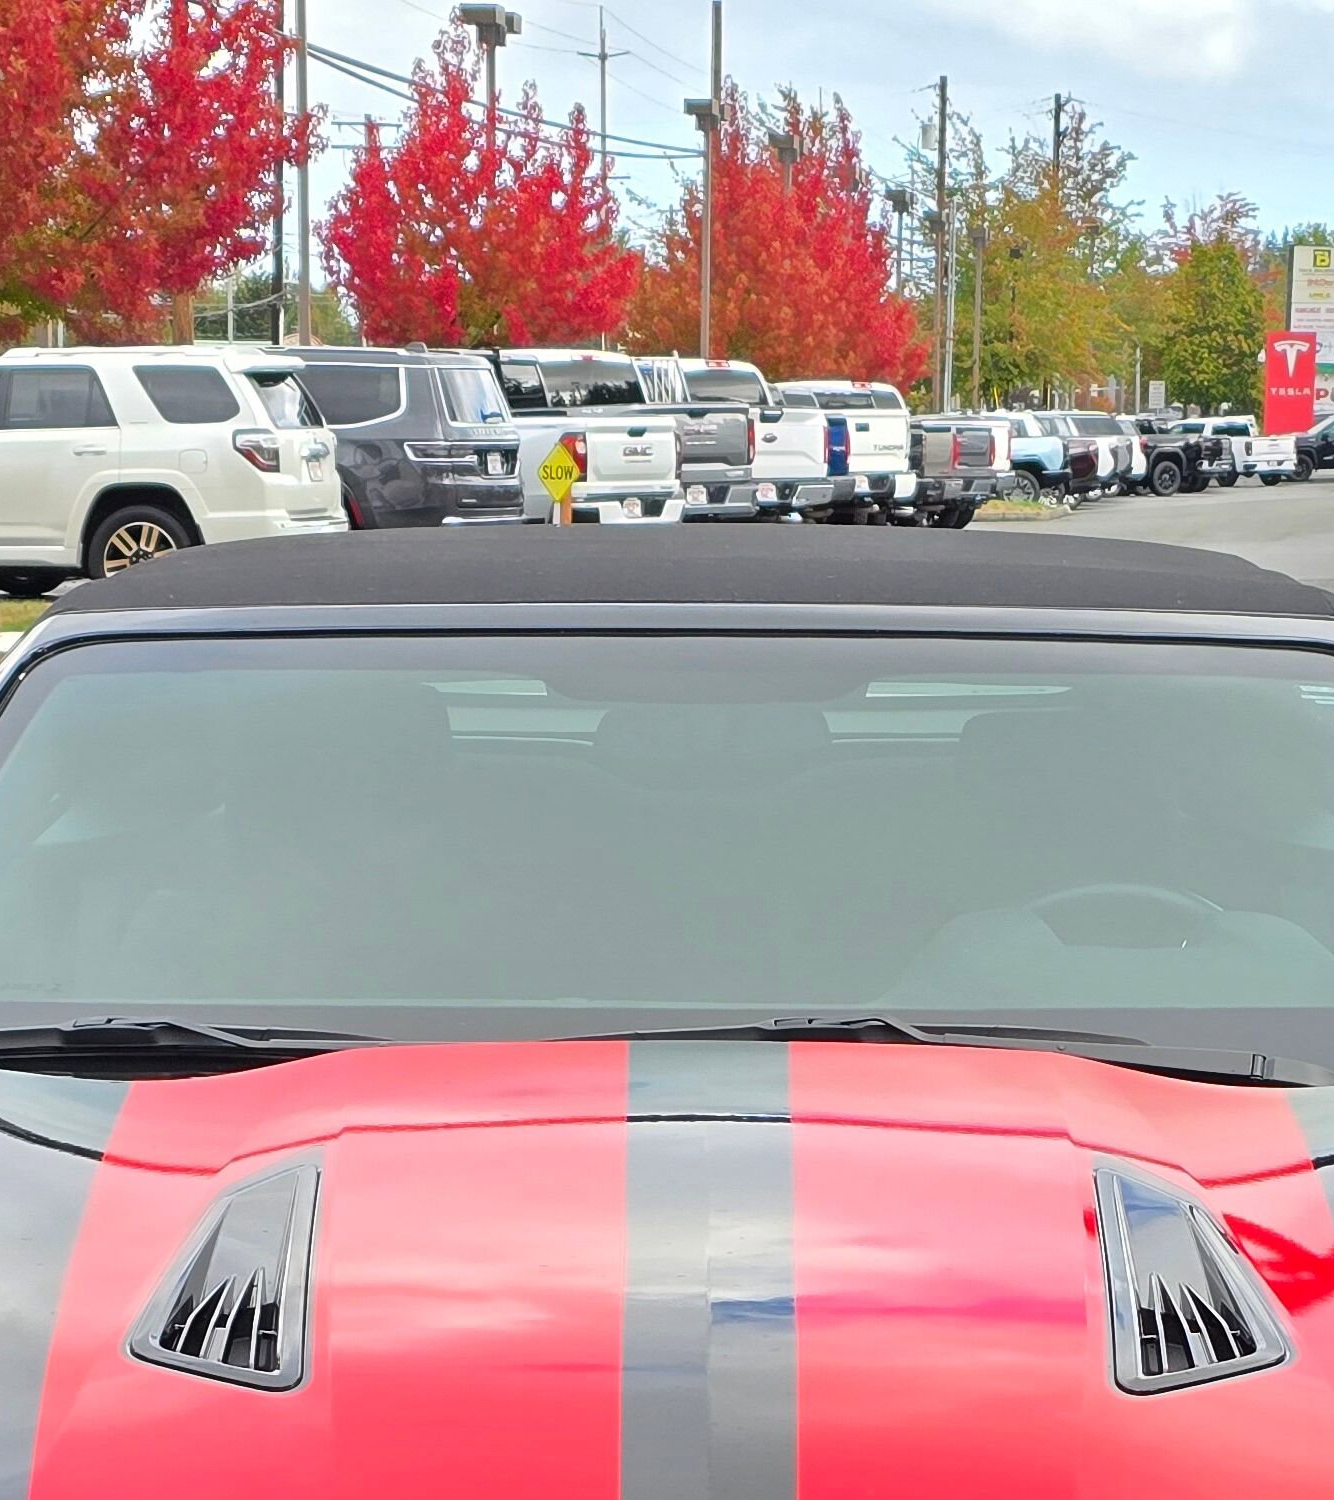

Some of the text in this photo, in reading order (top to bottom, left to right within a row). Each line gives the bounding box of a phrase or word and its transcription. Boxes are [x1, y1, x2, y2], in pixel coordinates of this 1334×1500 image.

[1269, 387, 1312, 396] TESLA
[622, 446, 654, 457] GMC
[542, 464, 574, 480] SLOW
